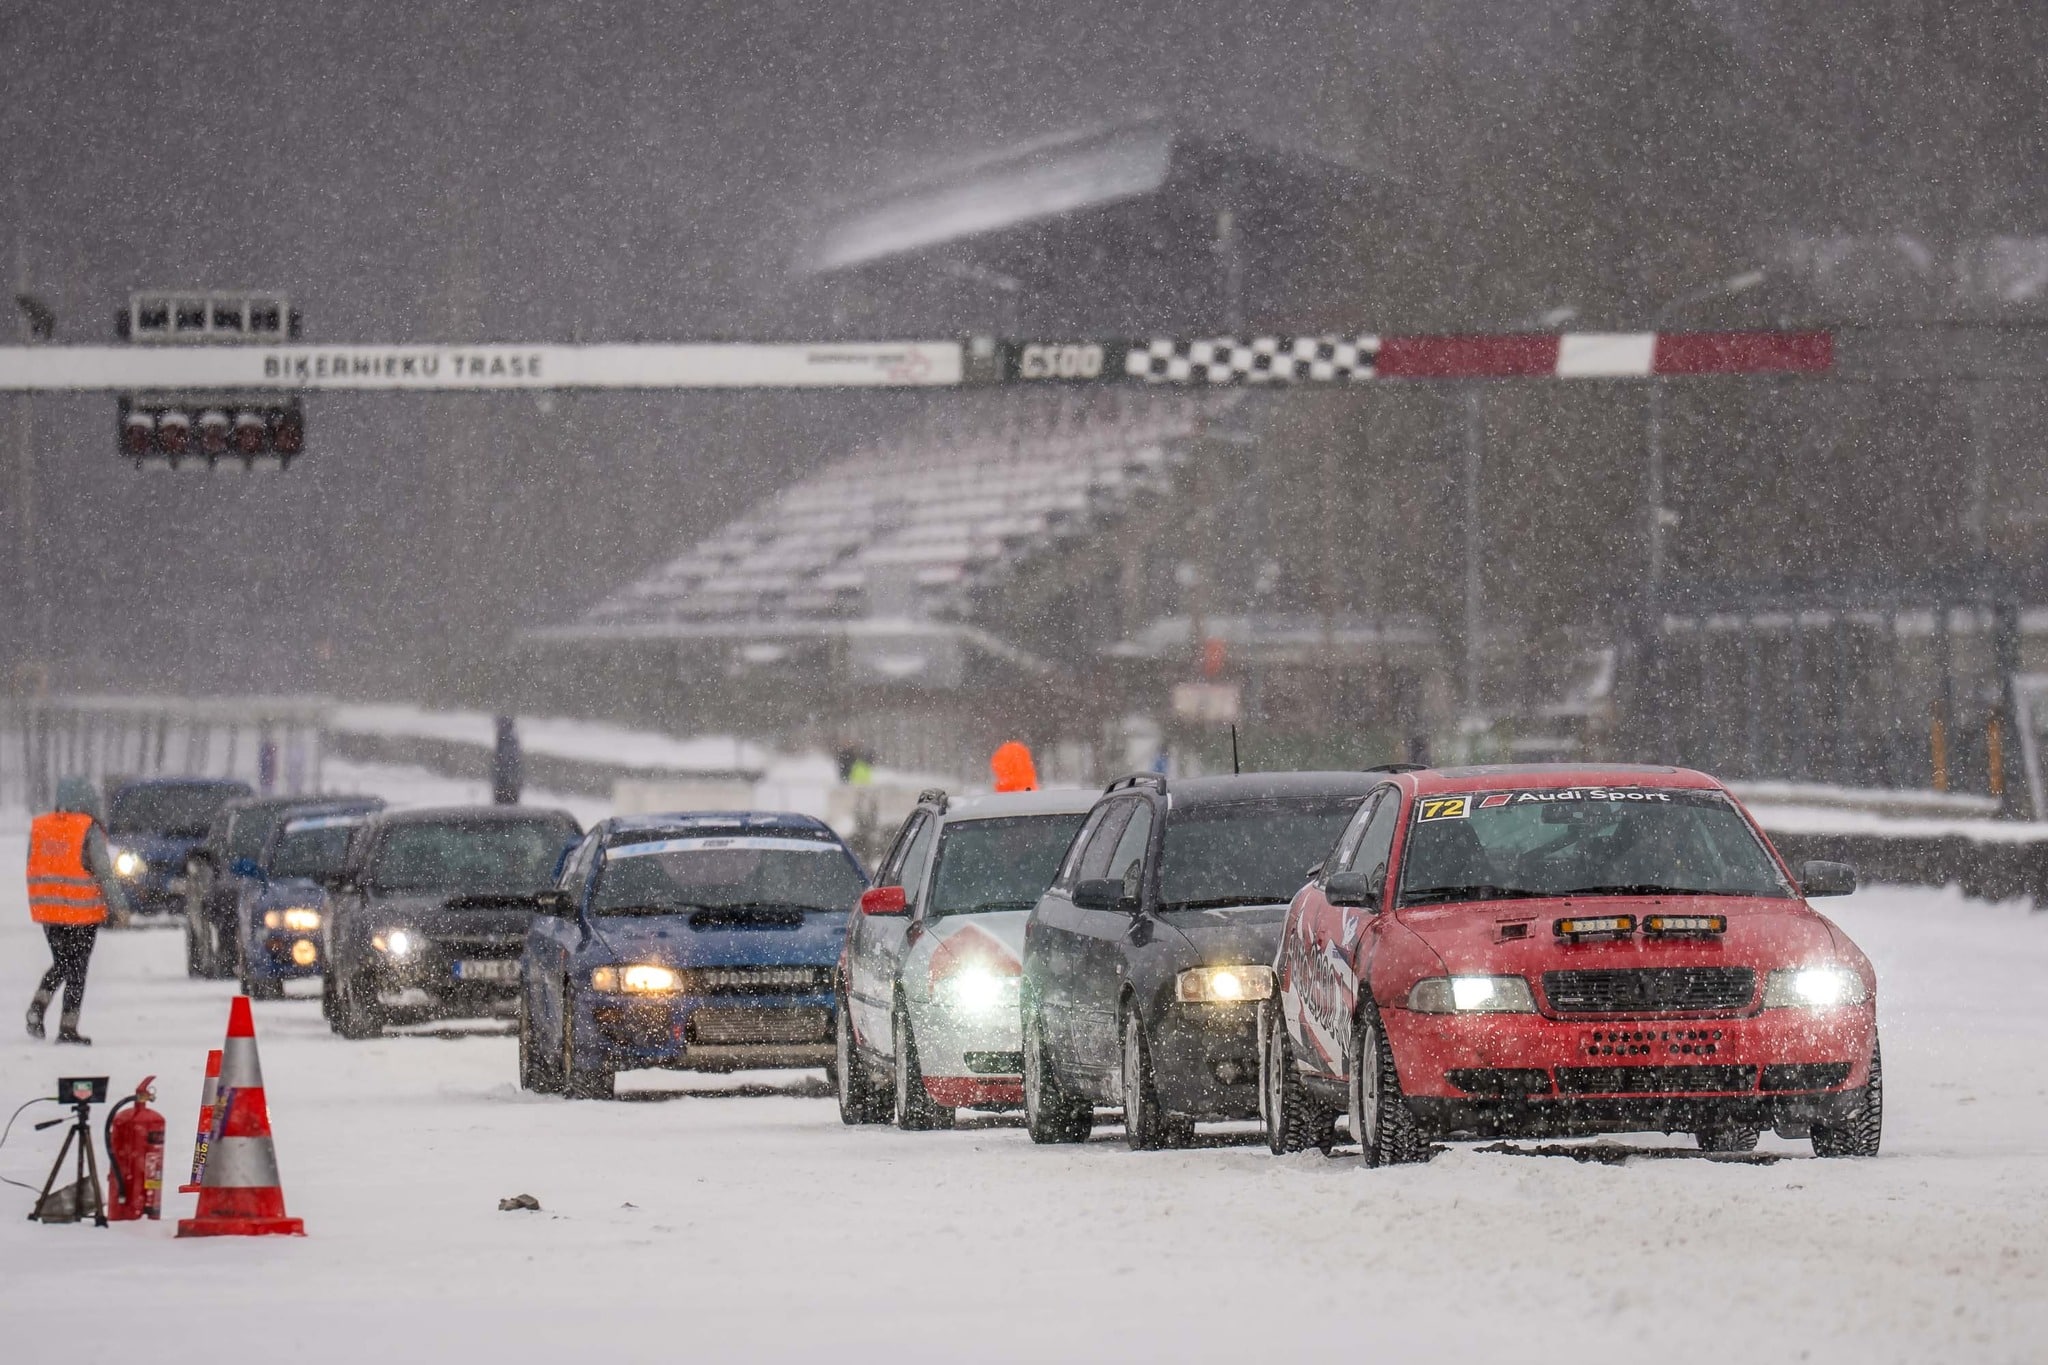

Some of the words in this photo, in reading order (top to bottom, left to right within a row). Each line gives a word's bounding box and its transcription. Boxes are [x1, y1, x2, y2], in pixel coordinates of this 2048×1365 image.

[1517, 790, 1583, 802] Audi
[1589, 790, 1671, 801] Sport
[1424, 800, 1464, 818] 72
